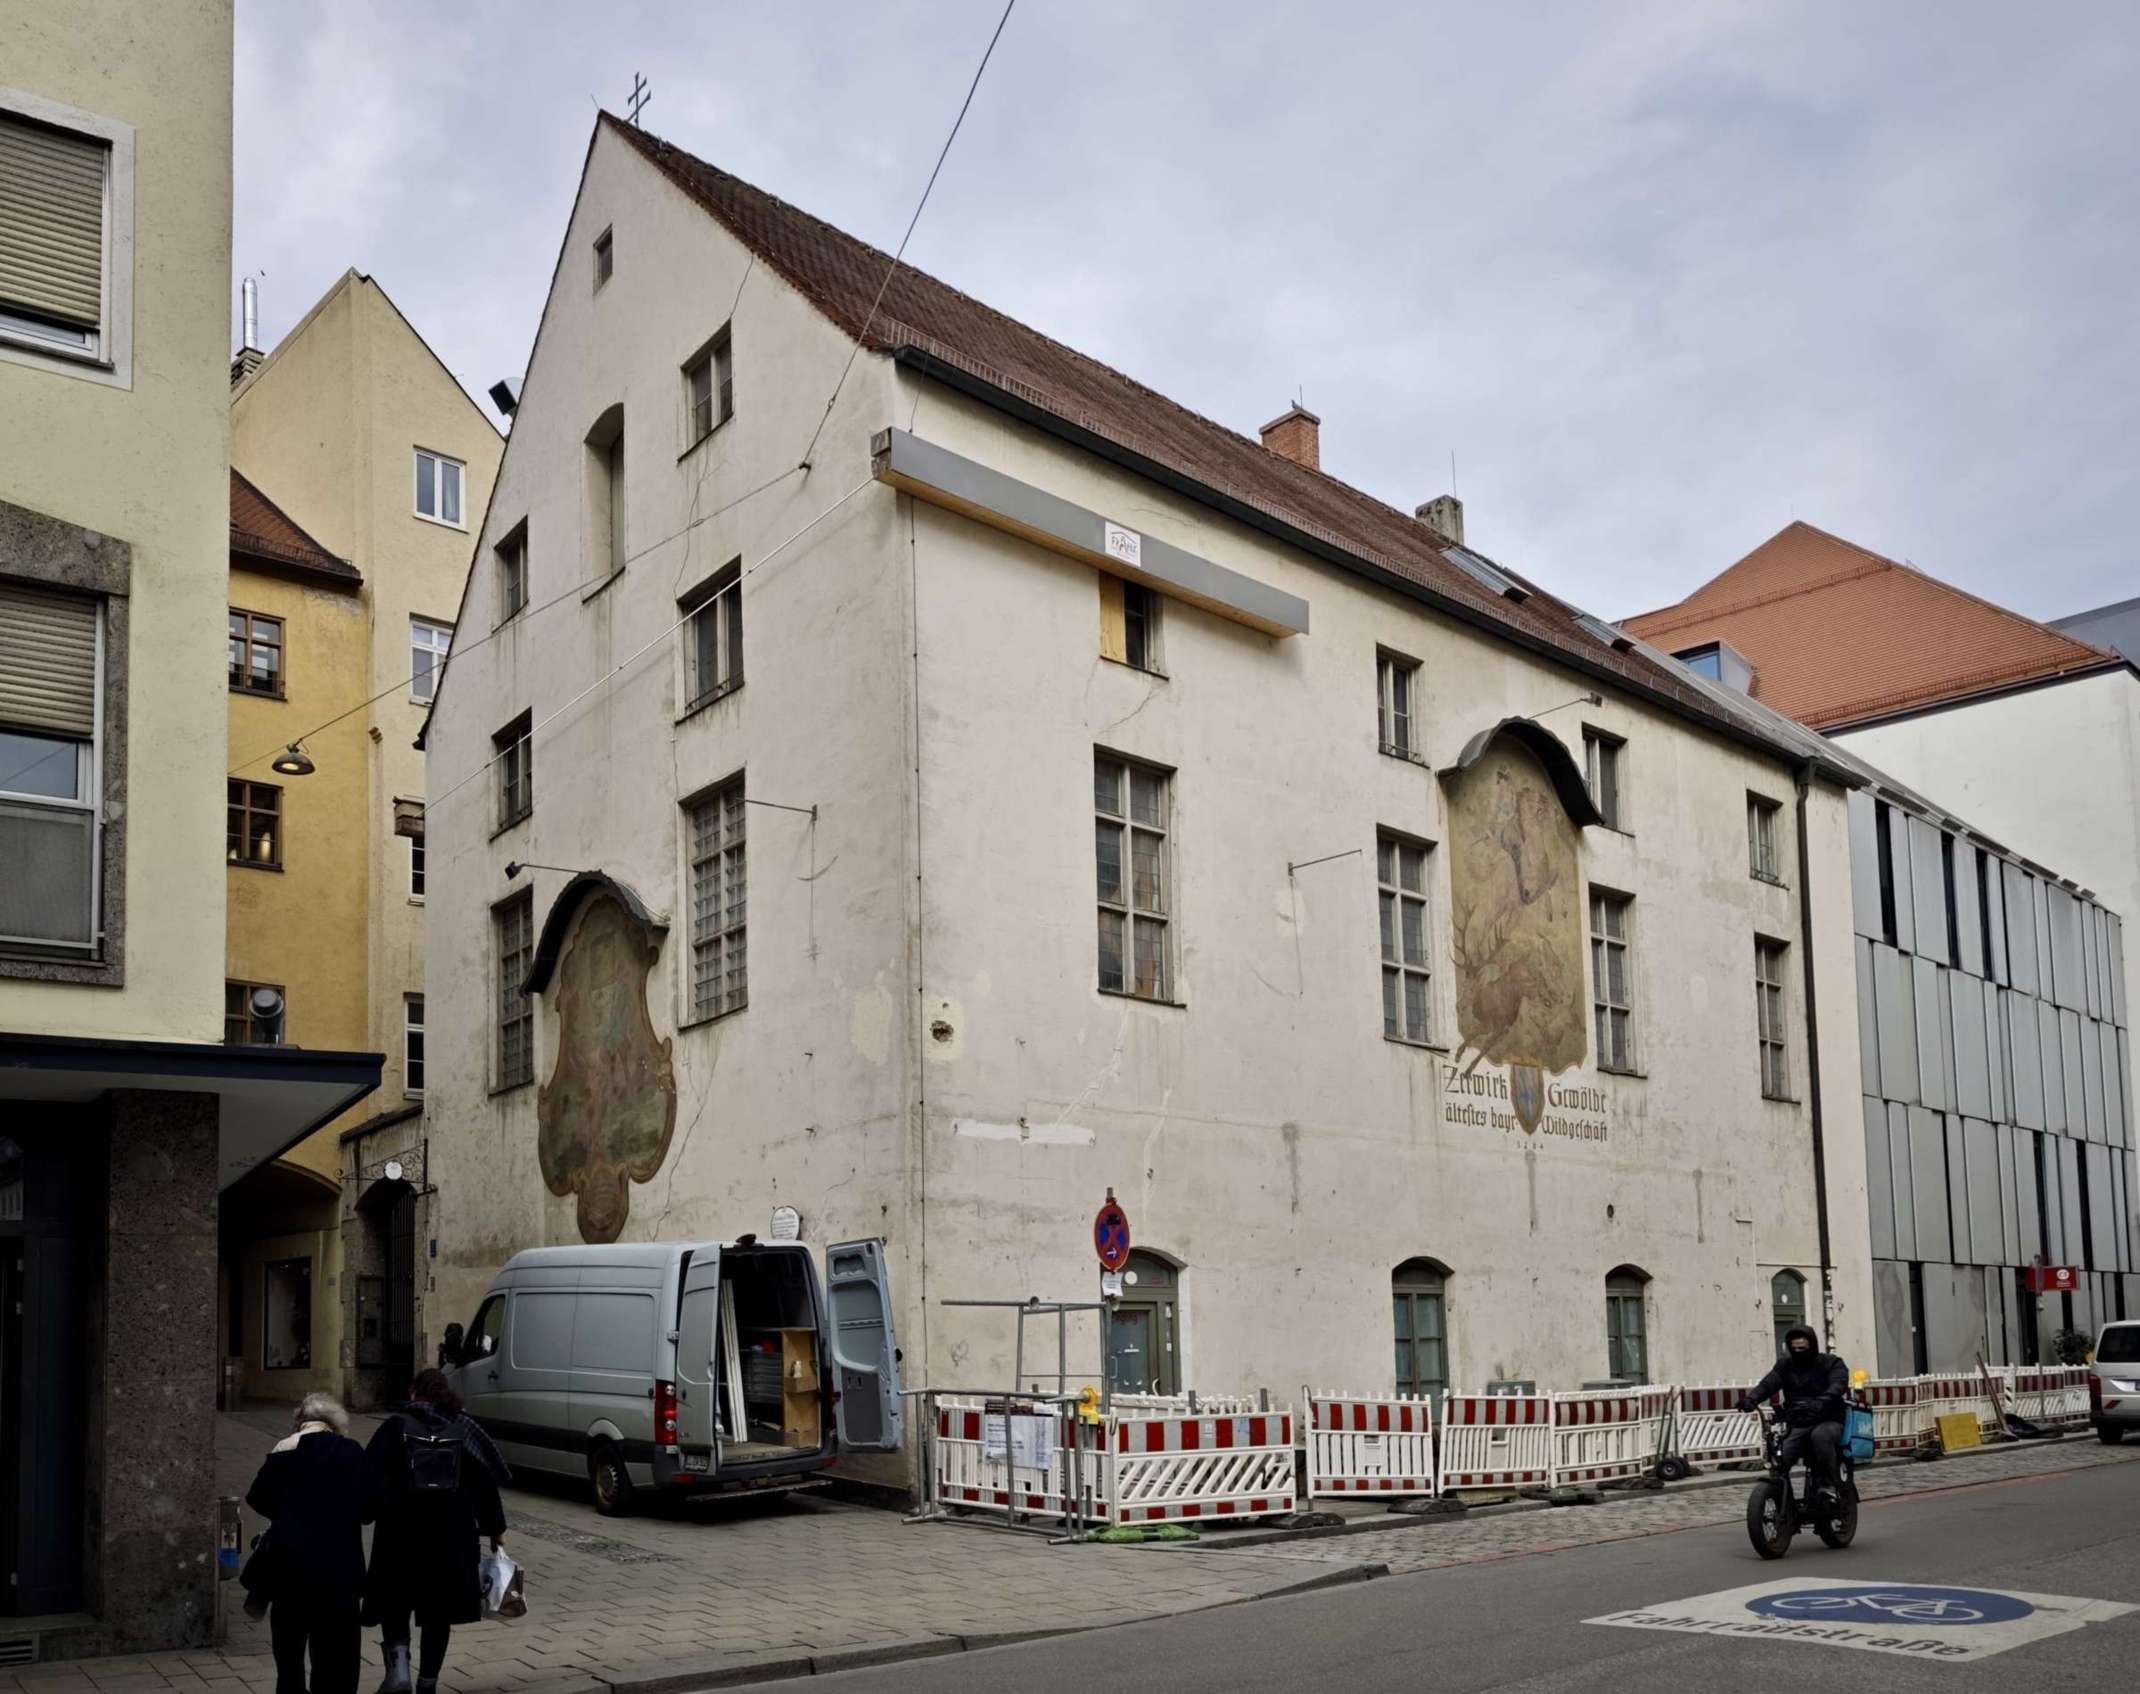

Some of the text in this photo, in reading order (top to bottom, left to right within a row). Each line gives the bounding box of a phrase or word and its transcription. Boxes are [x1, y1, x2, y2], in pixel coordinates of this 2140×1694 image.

[1442, 1064, 1606, 1114] Zerwirk Gewölbe
[1607, 1612, 1970, 1655] Fahrradstraße
